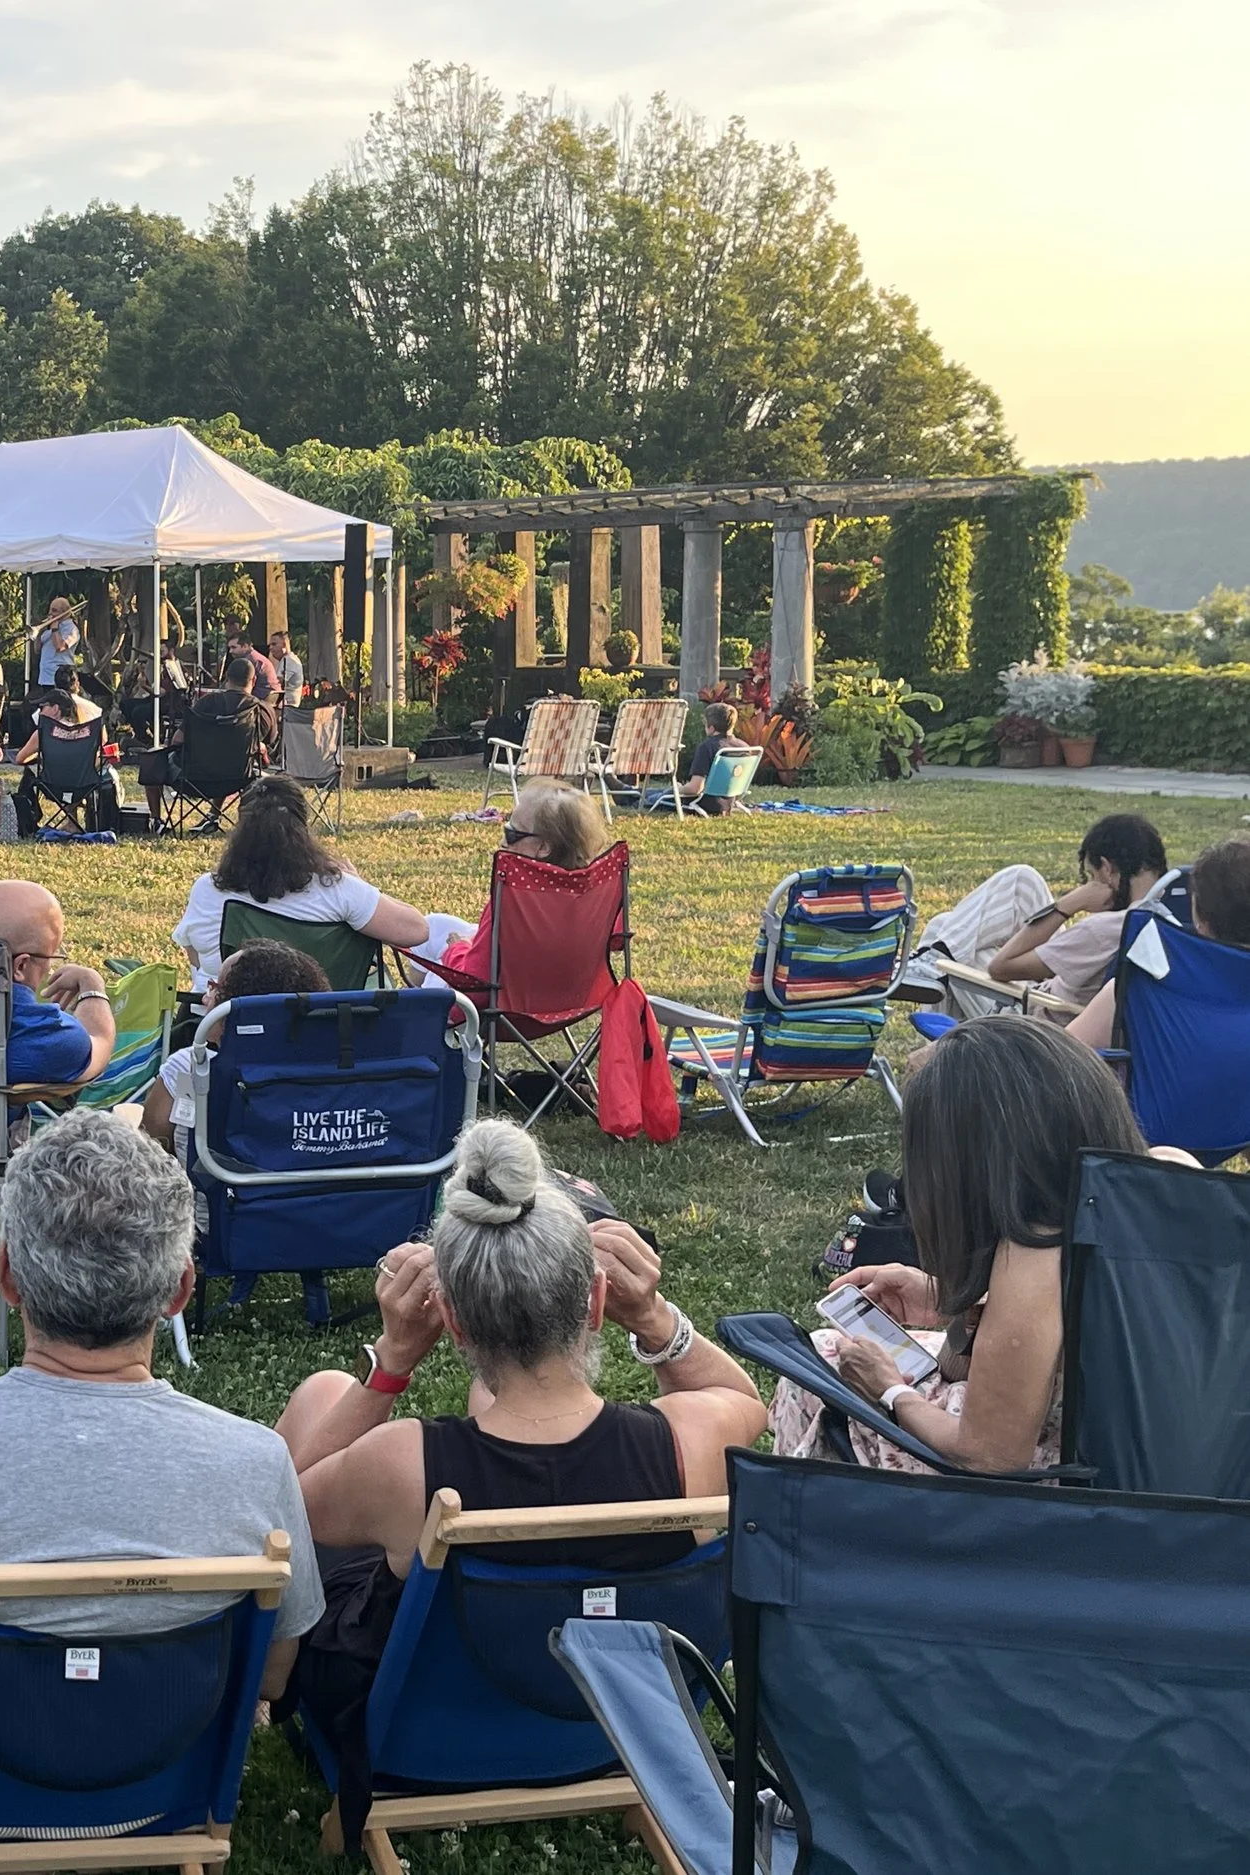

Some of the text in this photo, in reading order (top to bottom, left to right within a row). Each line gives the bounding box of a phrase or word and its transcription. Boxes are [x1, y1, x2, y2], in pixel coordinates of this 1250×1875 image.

[293, 1108, 367, 1127] LIVE THE
[292, 1121, 391, 1142] ISLAND LIFE
[291, 1137, 388, 1155] Tommy Bahama
[126, 1577, 158, 1586] BYER
[587, 1589, 612, 1600] BYER
[70, 1650, 96, 1660] BYER
